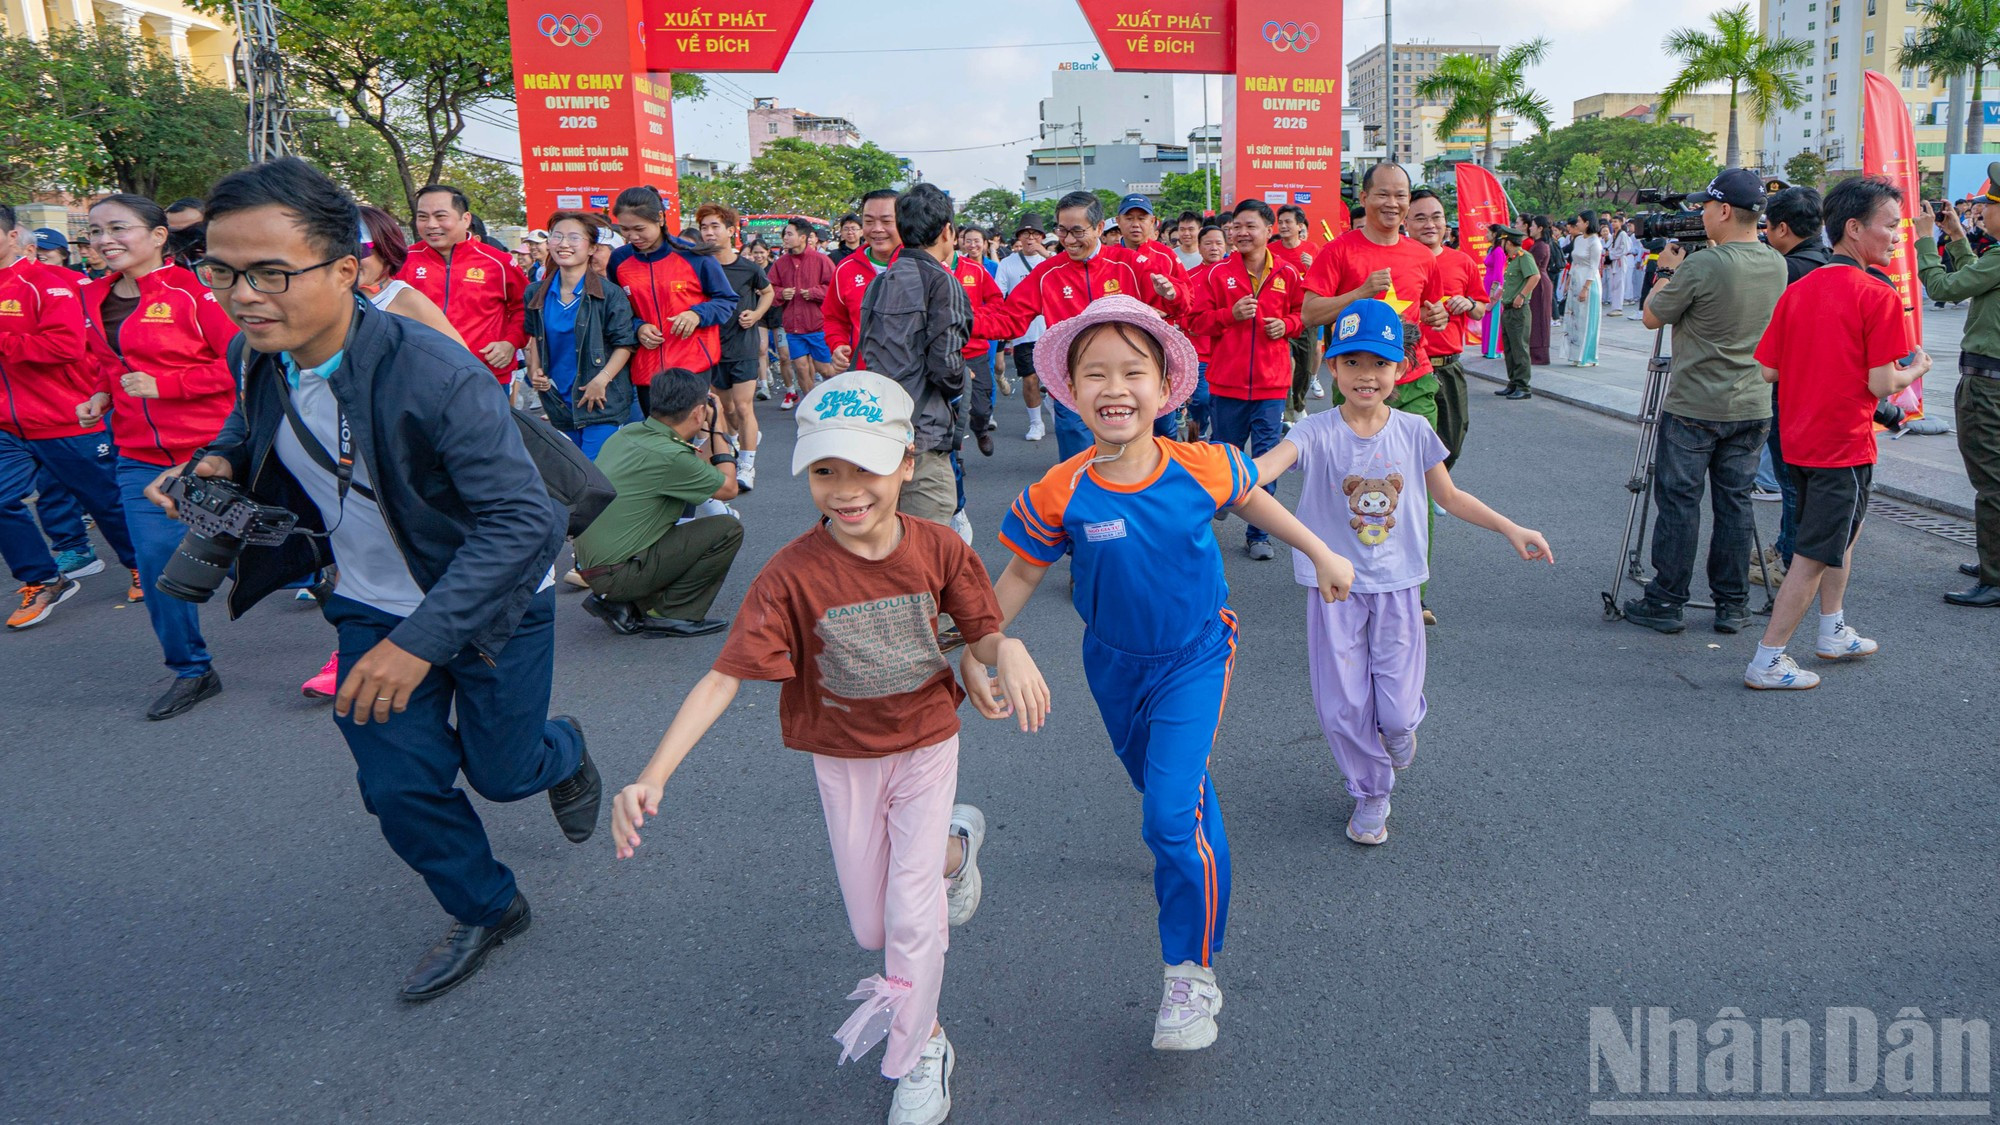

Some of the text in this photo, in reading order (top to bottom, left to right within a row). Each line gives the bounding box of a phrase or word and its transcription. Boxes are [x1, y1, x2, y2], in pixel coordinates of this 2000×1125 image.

[664, 7, 767, 26] XUẤT PHÁT
[1116, 9, 1212, 29] XUẤT PHÁT
[676, 33, 750, 52] VỀ ĐÍCH
[1126, 34, 1195, 53] VỀ ĐÍCH
[1058, 61, 1098, 71] ABBank
[523, 72, 624, 92] NGÀY CHẠY
[1245, 75, 1335, 95] NGÀY CHẠY
[545, 96, 610, 109] OLYMPIC
[1262, 98, 1321, 111] OLYMPIC
[559, 116, 598, 129] 2026
[1273, 116, 1308, 129] 2026
[532, 146, 541, 157] VÌ
[543, 145, 561, 157] SỨC
[586, 145, 609, 157] TOÀN
[610, 146, 628, 157] DÂN
[1246, 144, 1254, 155] VÌ
[1256, 144, 1272, 155] SỨC
[1295, 145, 1315, 156] TOÀN
[1317, 146, 1333, 156] DÂN
[540, 160, 549, 172] VÌ
[551, 162, 564, 172] AN
[565, 162, 586, 172] NINH
[600, 159, 623, 172] QUỐC
[1252, 158, 1260, 169] VÌ
[1262, 160, 1272, 169] AN
[1274, 160, 1293, 170] NINH
[1306, 158, 1327, 170] QUỐC
